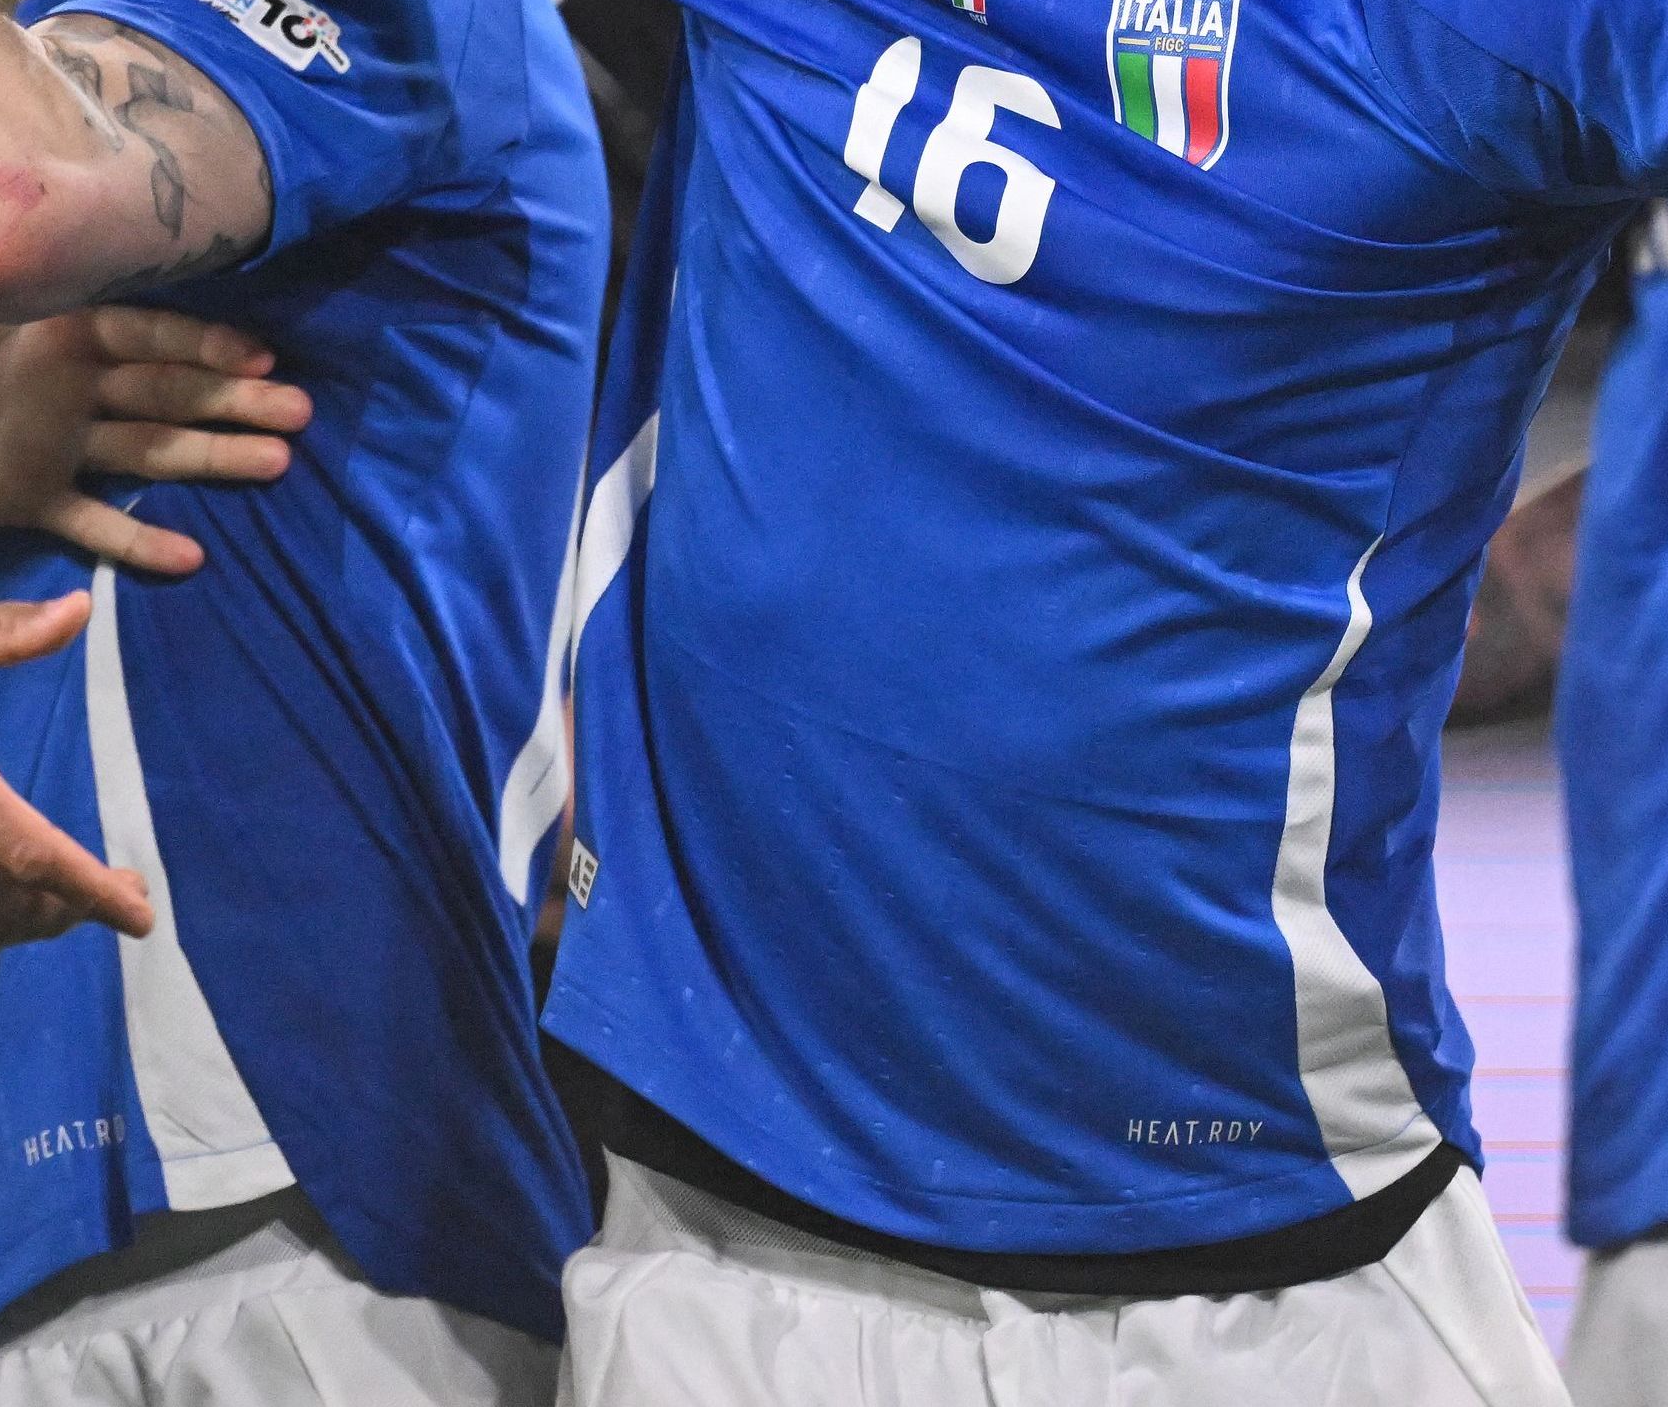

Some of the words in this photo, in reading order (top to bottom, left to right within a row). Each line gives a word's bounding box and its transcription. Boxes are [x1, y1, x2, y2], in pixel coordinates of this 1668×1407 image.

[1153, 36, 1185, 53] FIGC
[844, 36, 1060, 285] 16
[1128, 1119, 1263, 1146] HEAT.RDY
